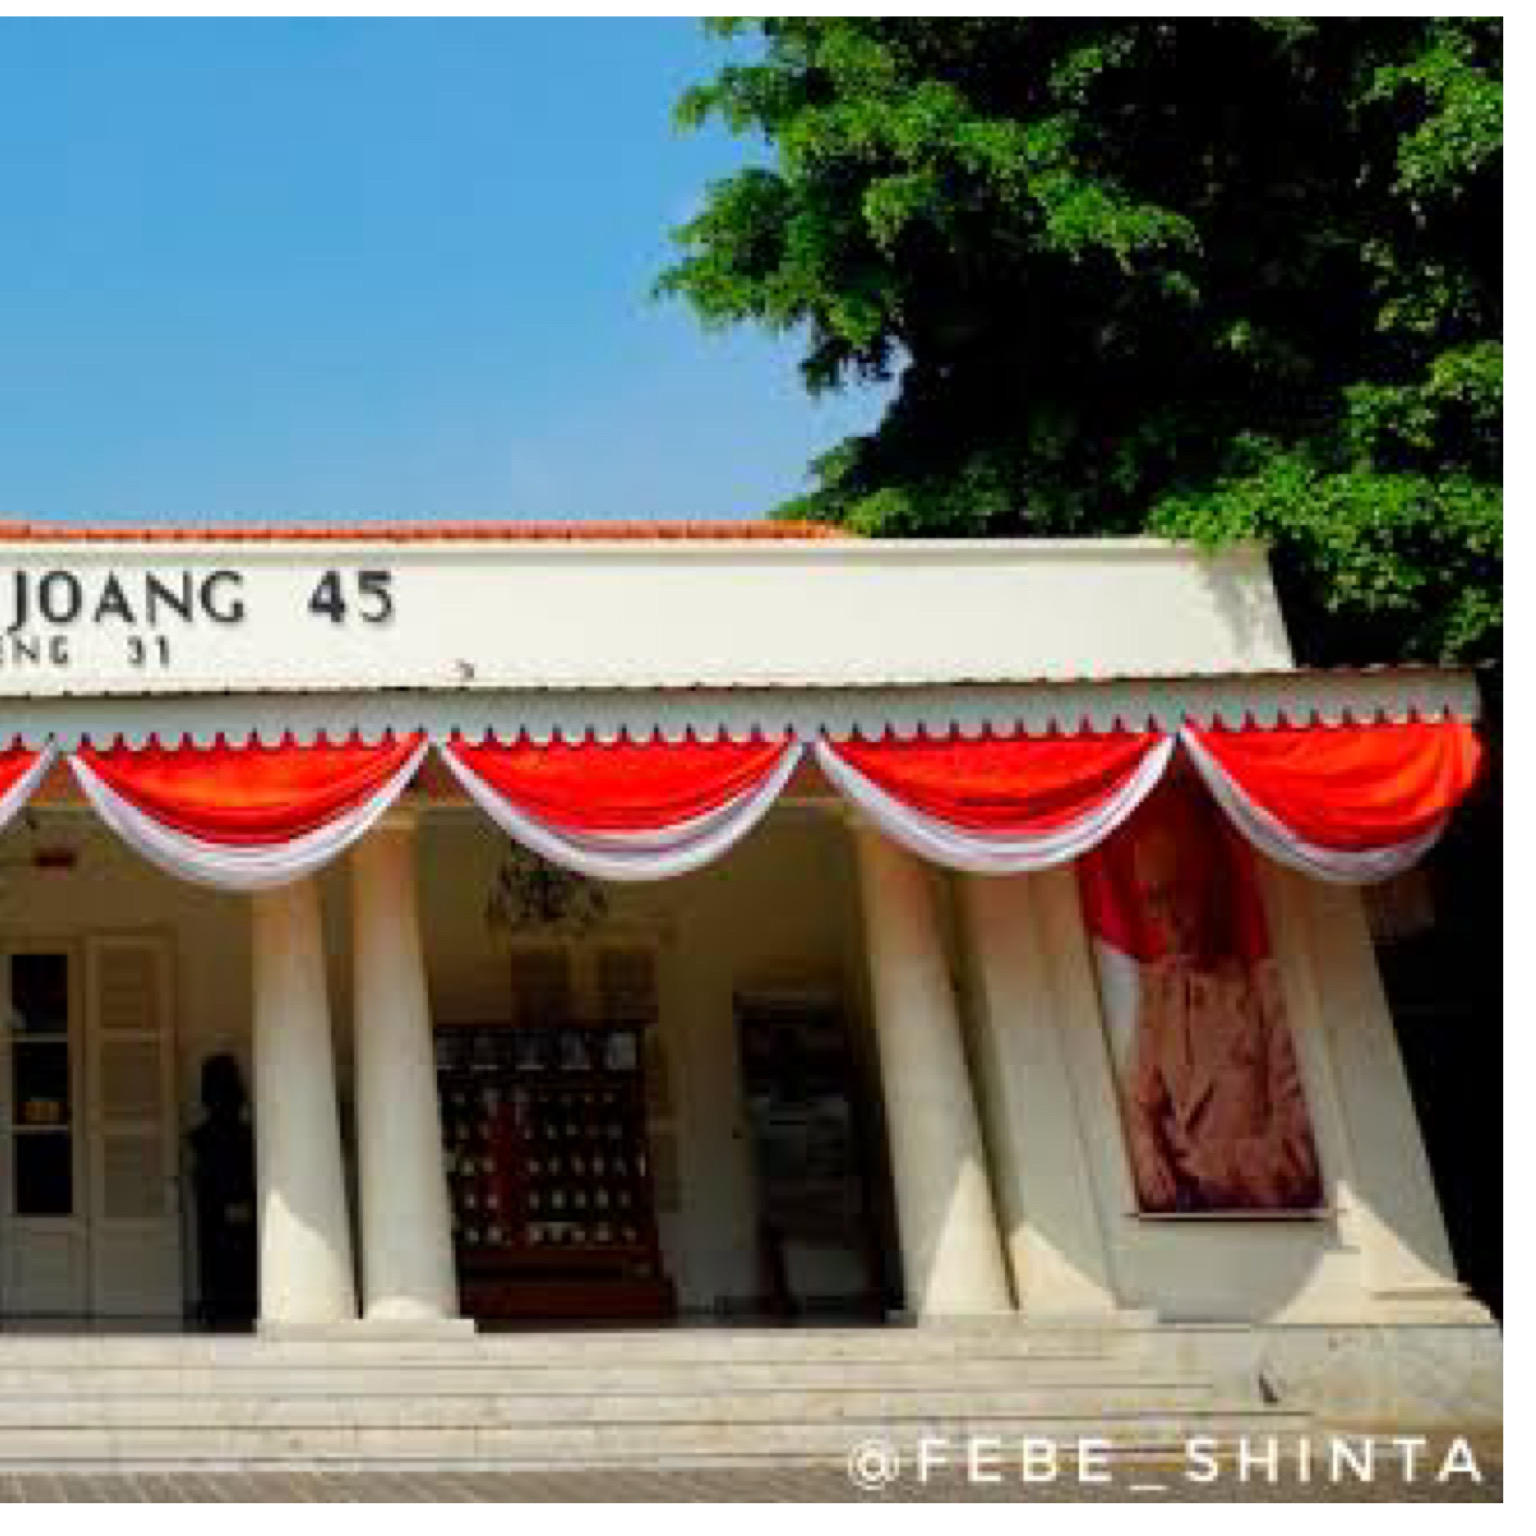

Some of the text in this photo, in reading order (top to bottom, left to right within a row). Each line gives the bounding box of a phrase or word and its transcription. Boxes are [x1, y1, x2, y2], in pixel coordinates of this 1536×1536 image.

[7, 569, 247, 633] JOANG
[306, 569, 396, 625] 45
[126, 634, 172, 667] 31
